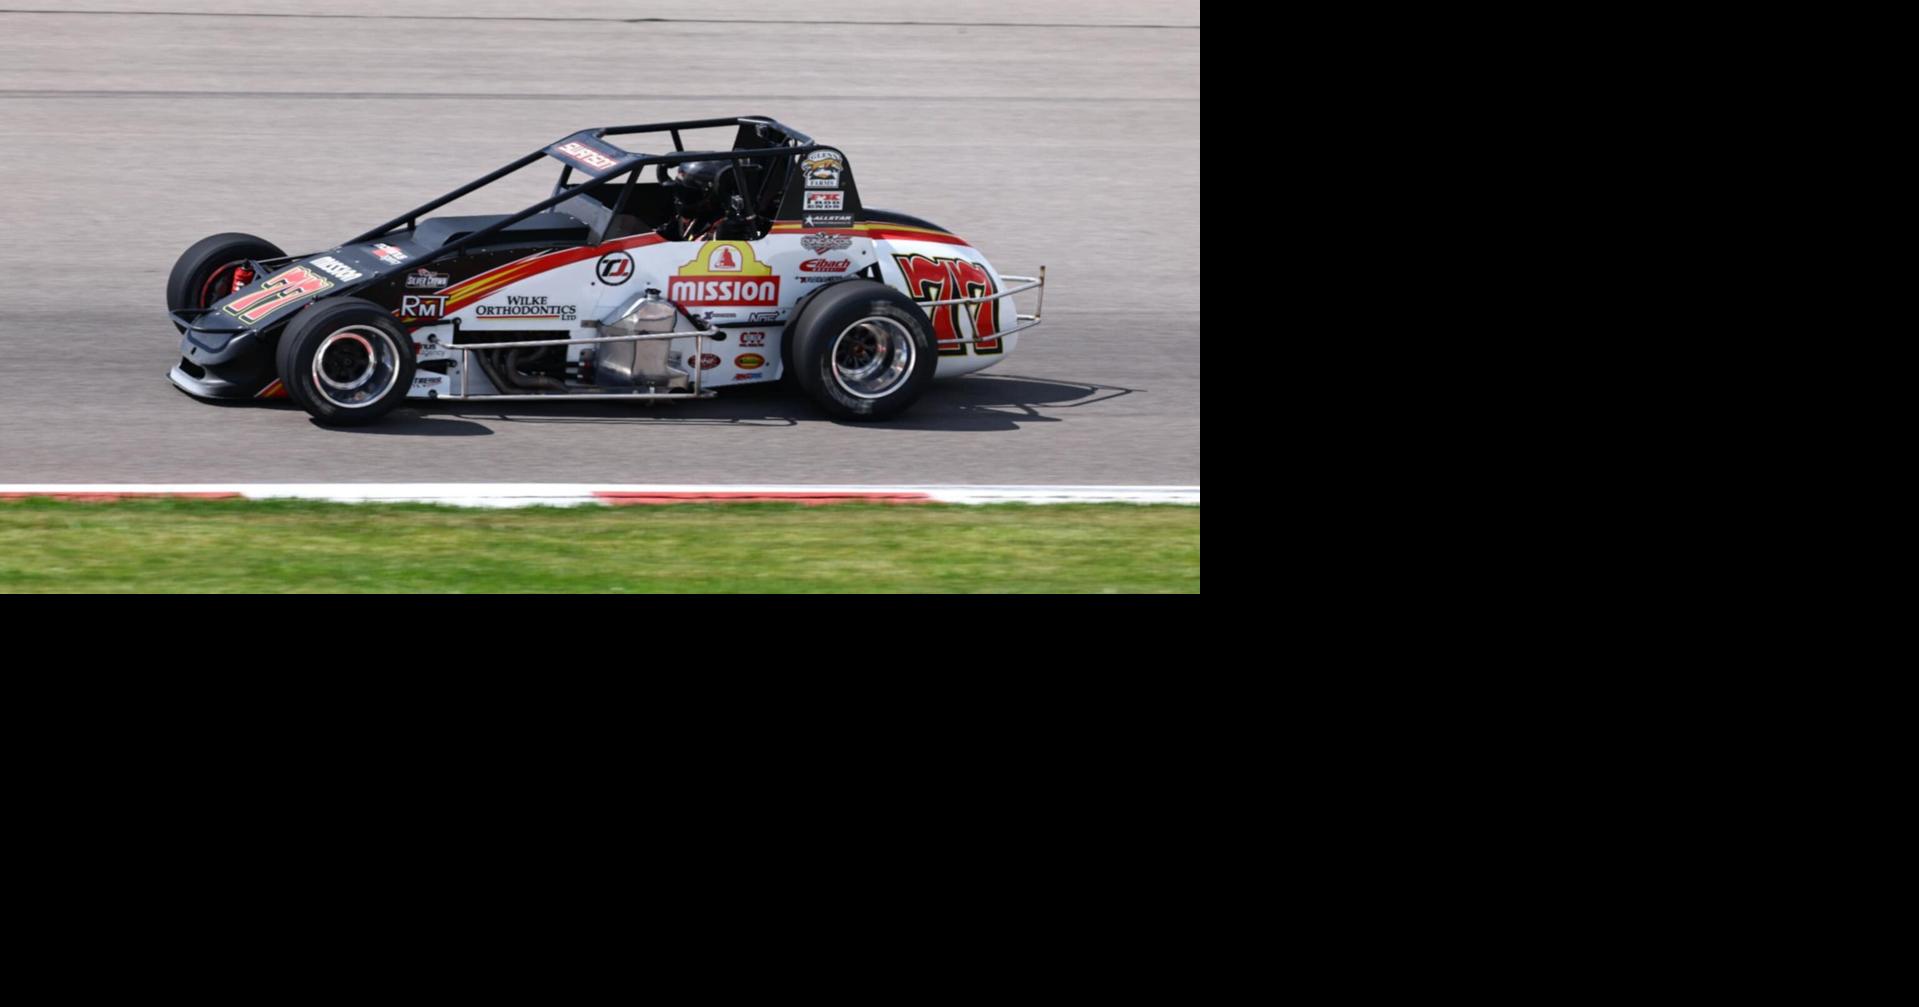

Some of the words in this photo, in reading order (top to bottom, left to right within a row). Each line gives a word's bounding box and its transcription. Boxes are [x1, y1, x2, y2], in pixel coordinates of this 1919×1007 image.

[799, 259, 850, 272] Eibach
[223, 266, 334, 325] 77
[672, 281, 776, 301] MISSION
[507, 296, 547, 306] WILKE
[892, 253, 1003, 355] 77
[476, 305, 576, 316] ORTHODONTICS
